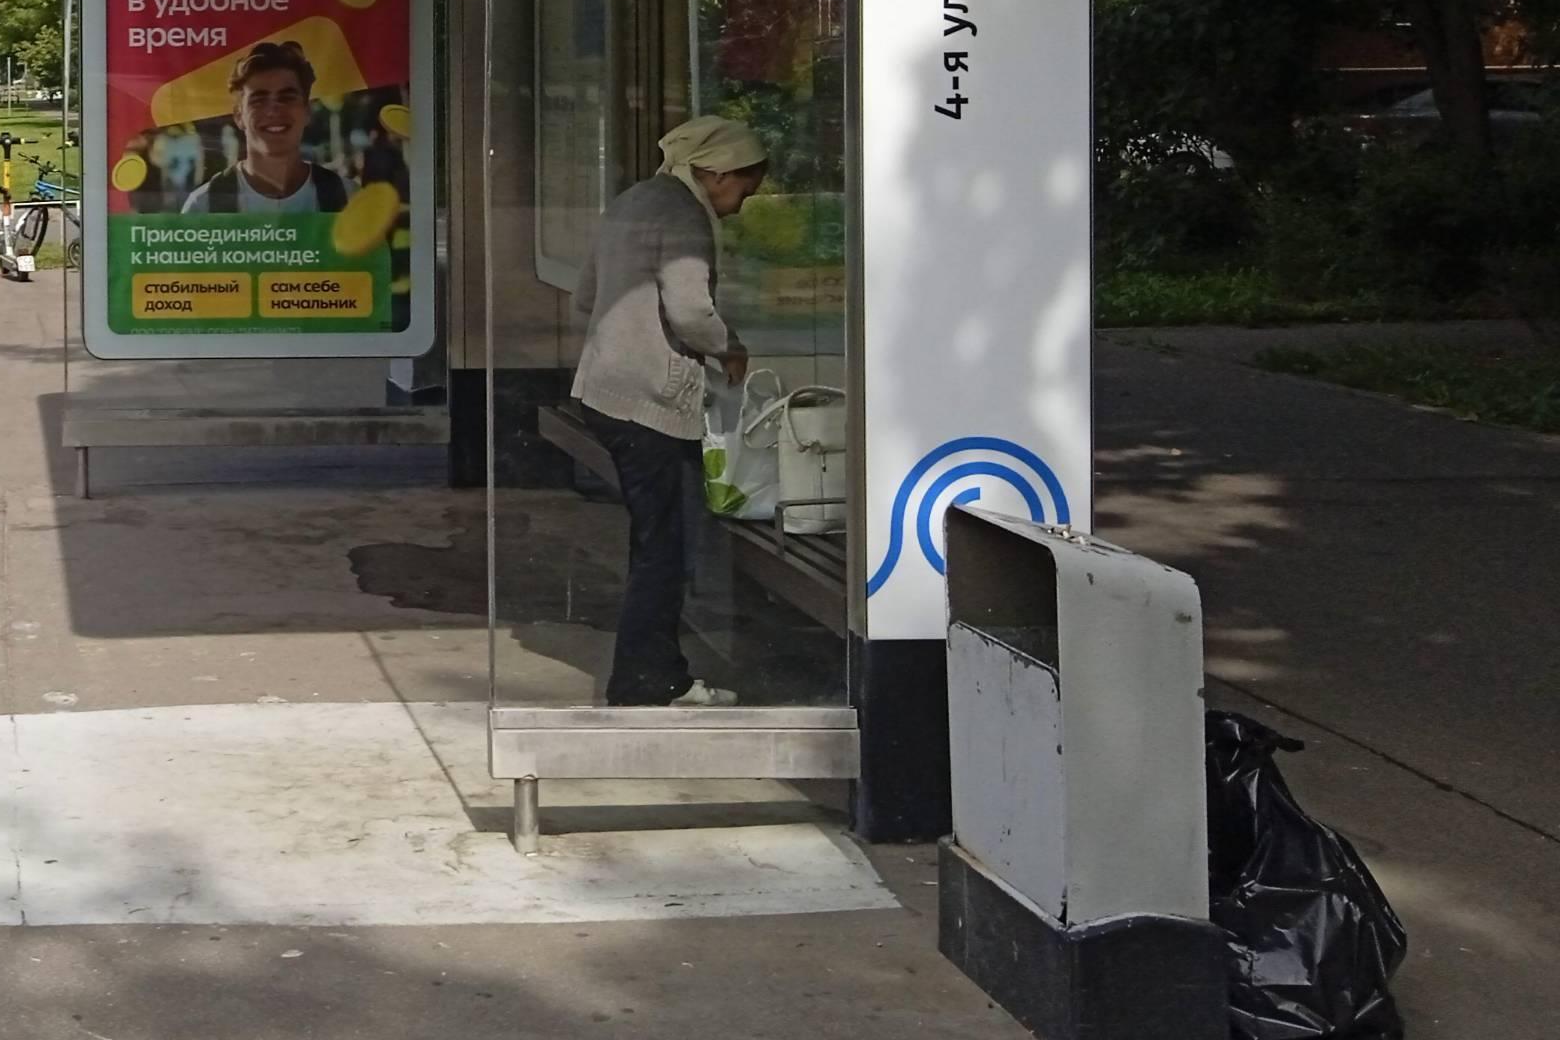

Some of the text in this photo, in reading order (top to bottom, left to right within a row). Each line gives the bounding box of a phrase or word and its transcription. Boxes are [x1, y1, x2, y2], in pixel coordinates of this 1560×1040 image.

[128, 27, 227, 53] время
[934, 51, 969, 120] 4-я
[130, 225, 297, 246] Присоединяйся
[130, 246, 320, 265] к нашей команде:
[144, 280, 239, 294] стабильный
[271, 280, 340, 293] сам себе
[144, 299, 192, 312] доход
[271, 298, 357, 310] начальник
